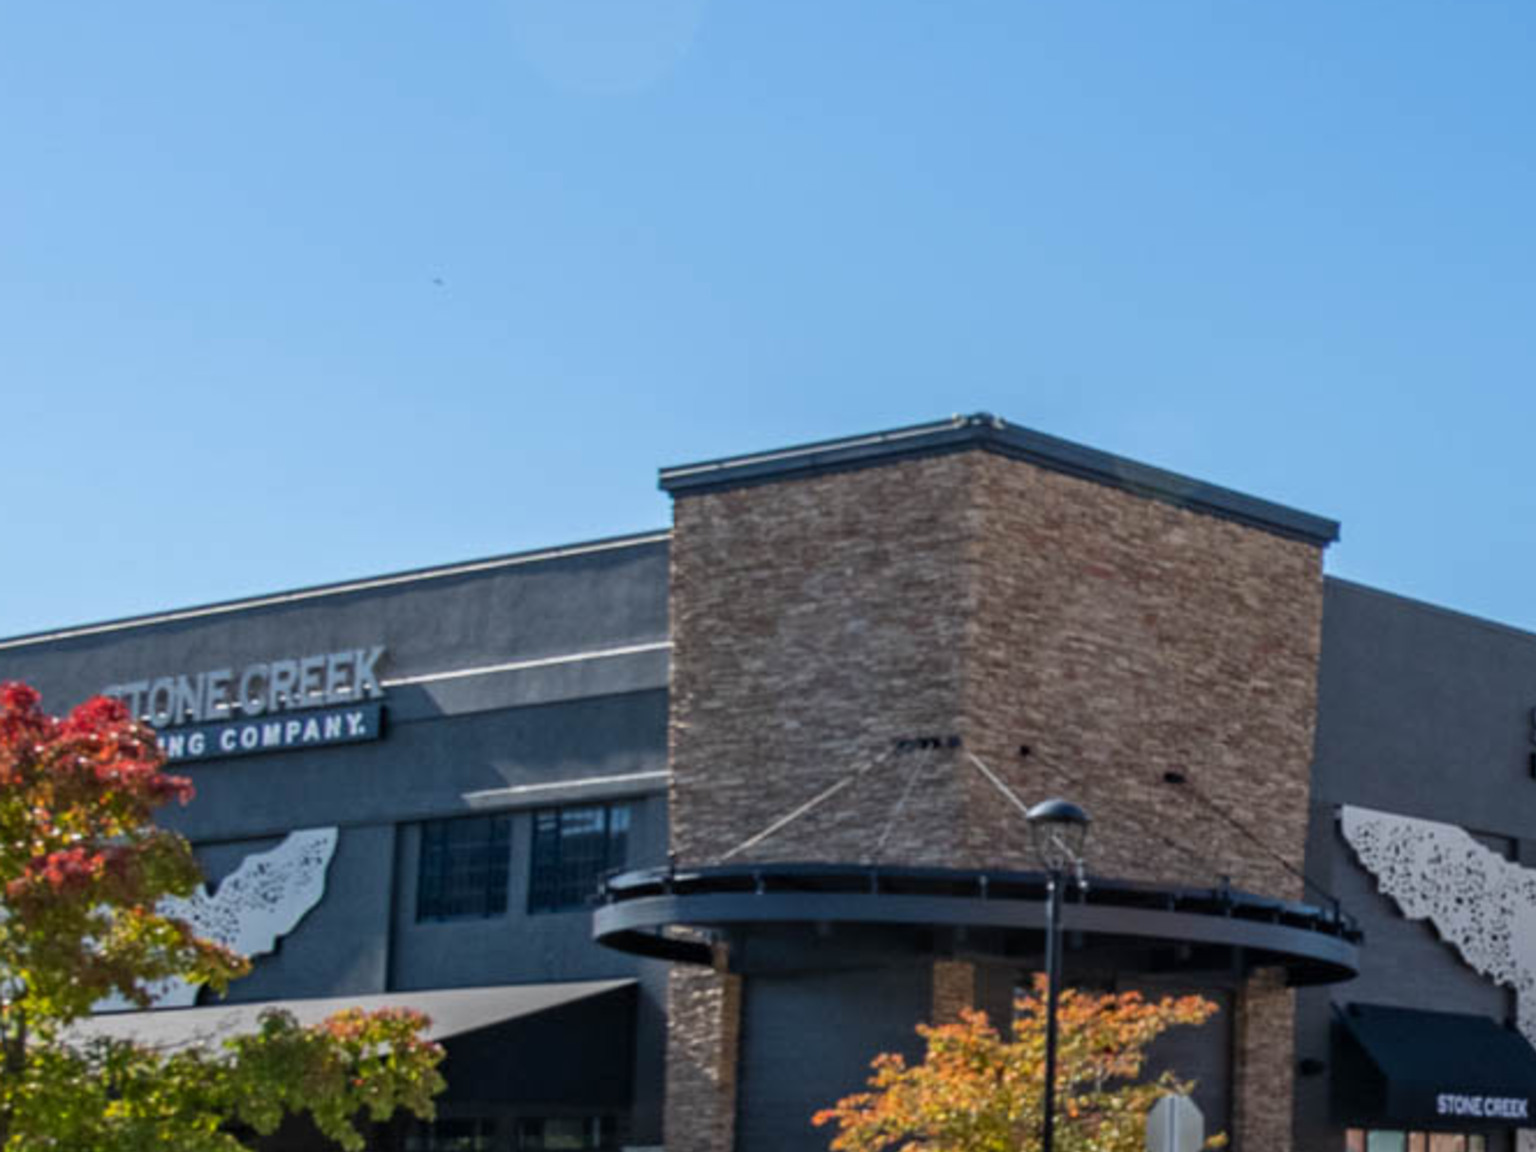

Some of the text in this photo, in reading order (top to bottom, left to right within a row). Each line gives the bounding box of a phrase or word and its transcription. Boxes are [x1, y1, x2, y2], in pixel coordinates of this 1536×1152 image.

[238, 645, 385, 714] CREEK
[1437, 1094, 1528, 1118] STONE CREEK
